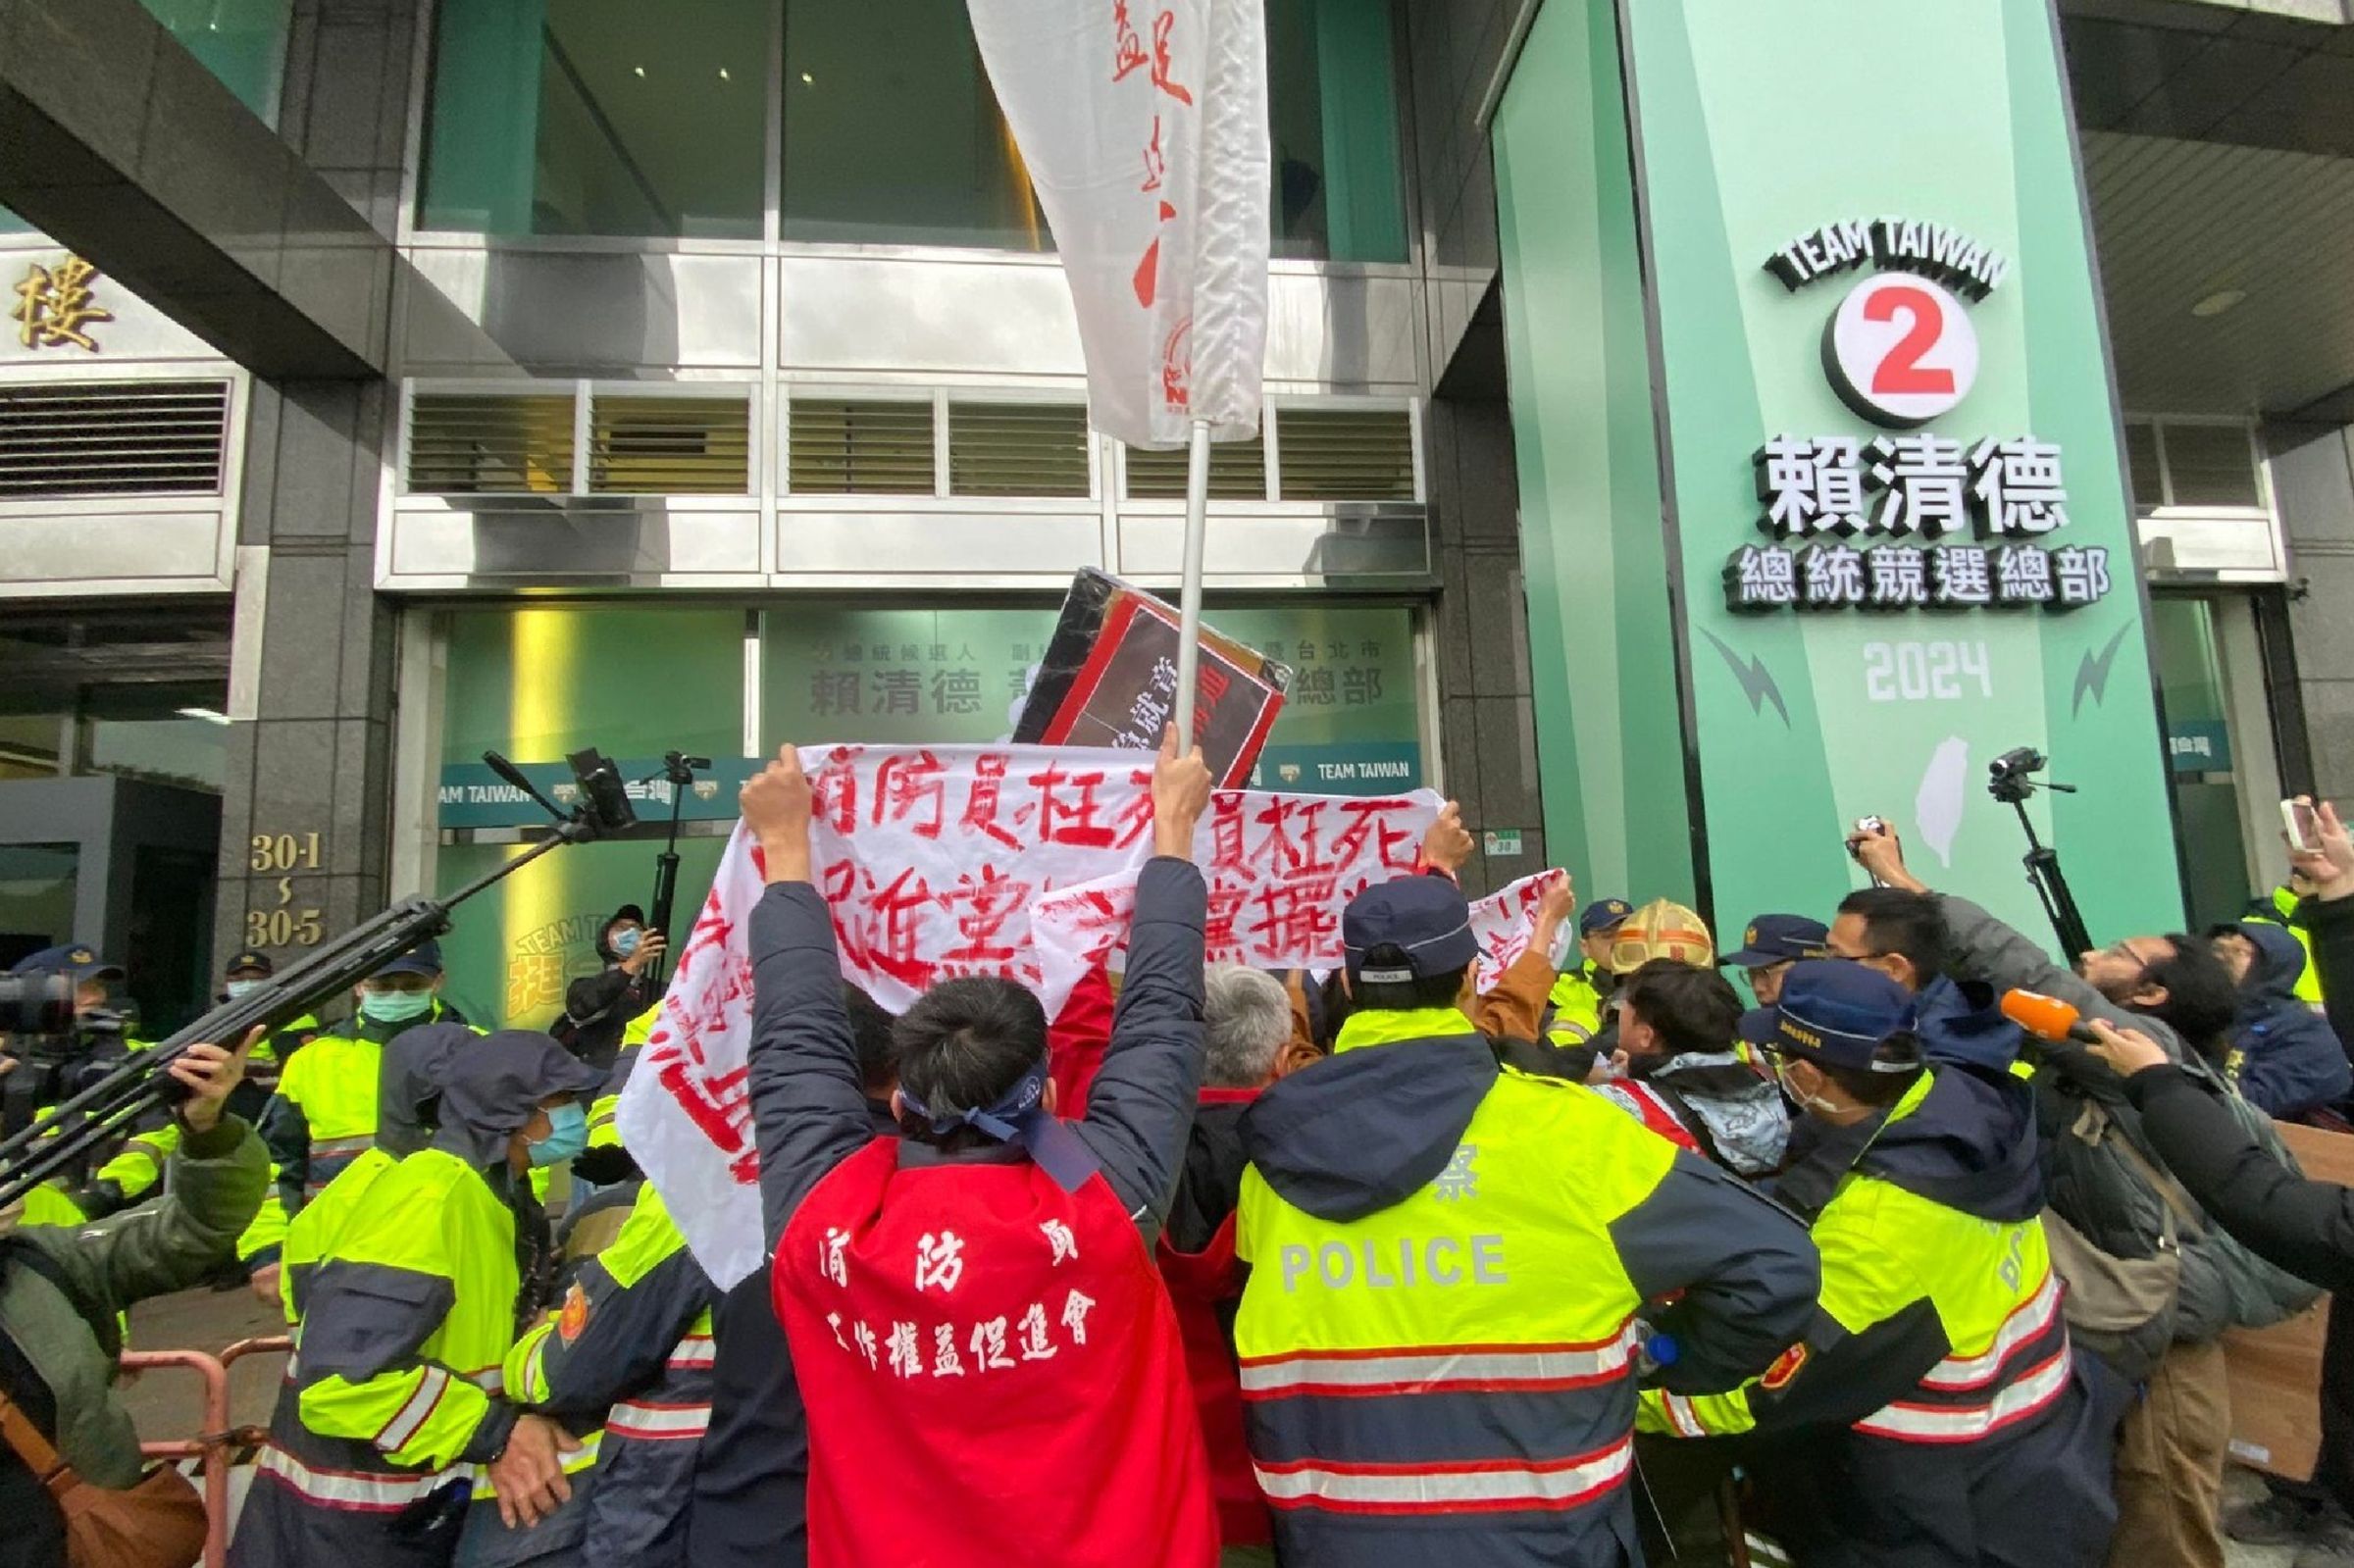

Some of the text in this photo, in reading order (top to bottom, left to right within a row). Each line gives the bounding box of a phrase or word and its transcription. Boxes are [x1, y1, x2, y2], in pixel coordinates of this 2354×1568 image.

[1777, 218, 2011, 288] TEAM TAIWAN
[1863, 285, 1956, 394] 2
[1765, 432, 2070, 534] 賴清德
[1738, 544, 2110, 603] 總統競選總部
[809, 668, 982, 717] 賴清德
[1864, 640, 1993, 702] 2024
[438, 784, 531, 804] AM TAIWAN
[1317, 763, 1356, 781] TEAM
[1358, 760, 1409, 779] TAIWAN
[251, 832, 320, 871] 30-1
[246, 909, 322, 947] 30-5
[516, 918, 584, 954] TEAM
[1280, 1235, 1509, 1293] POLICE
